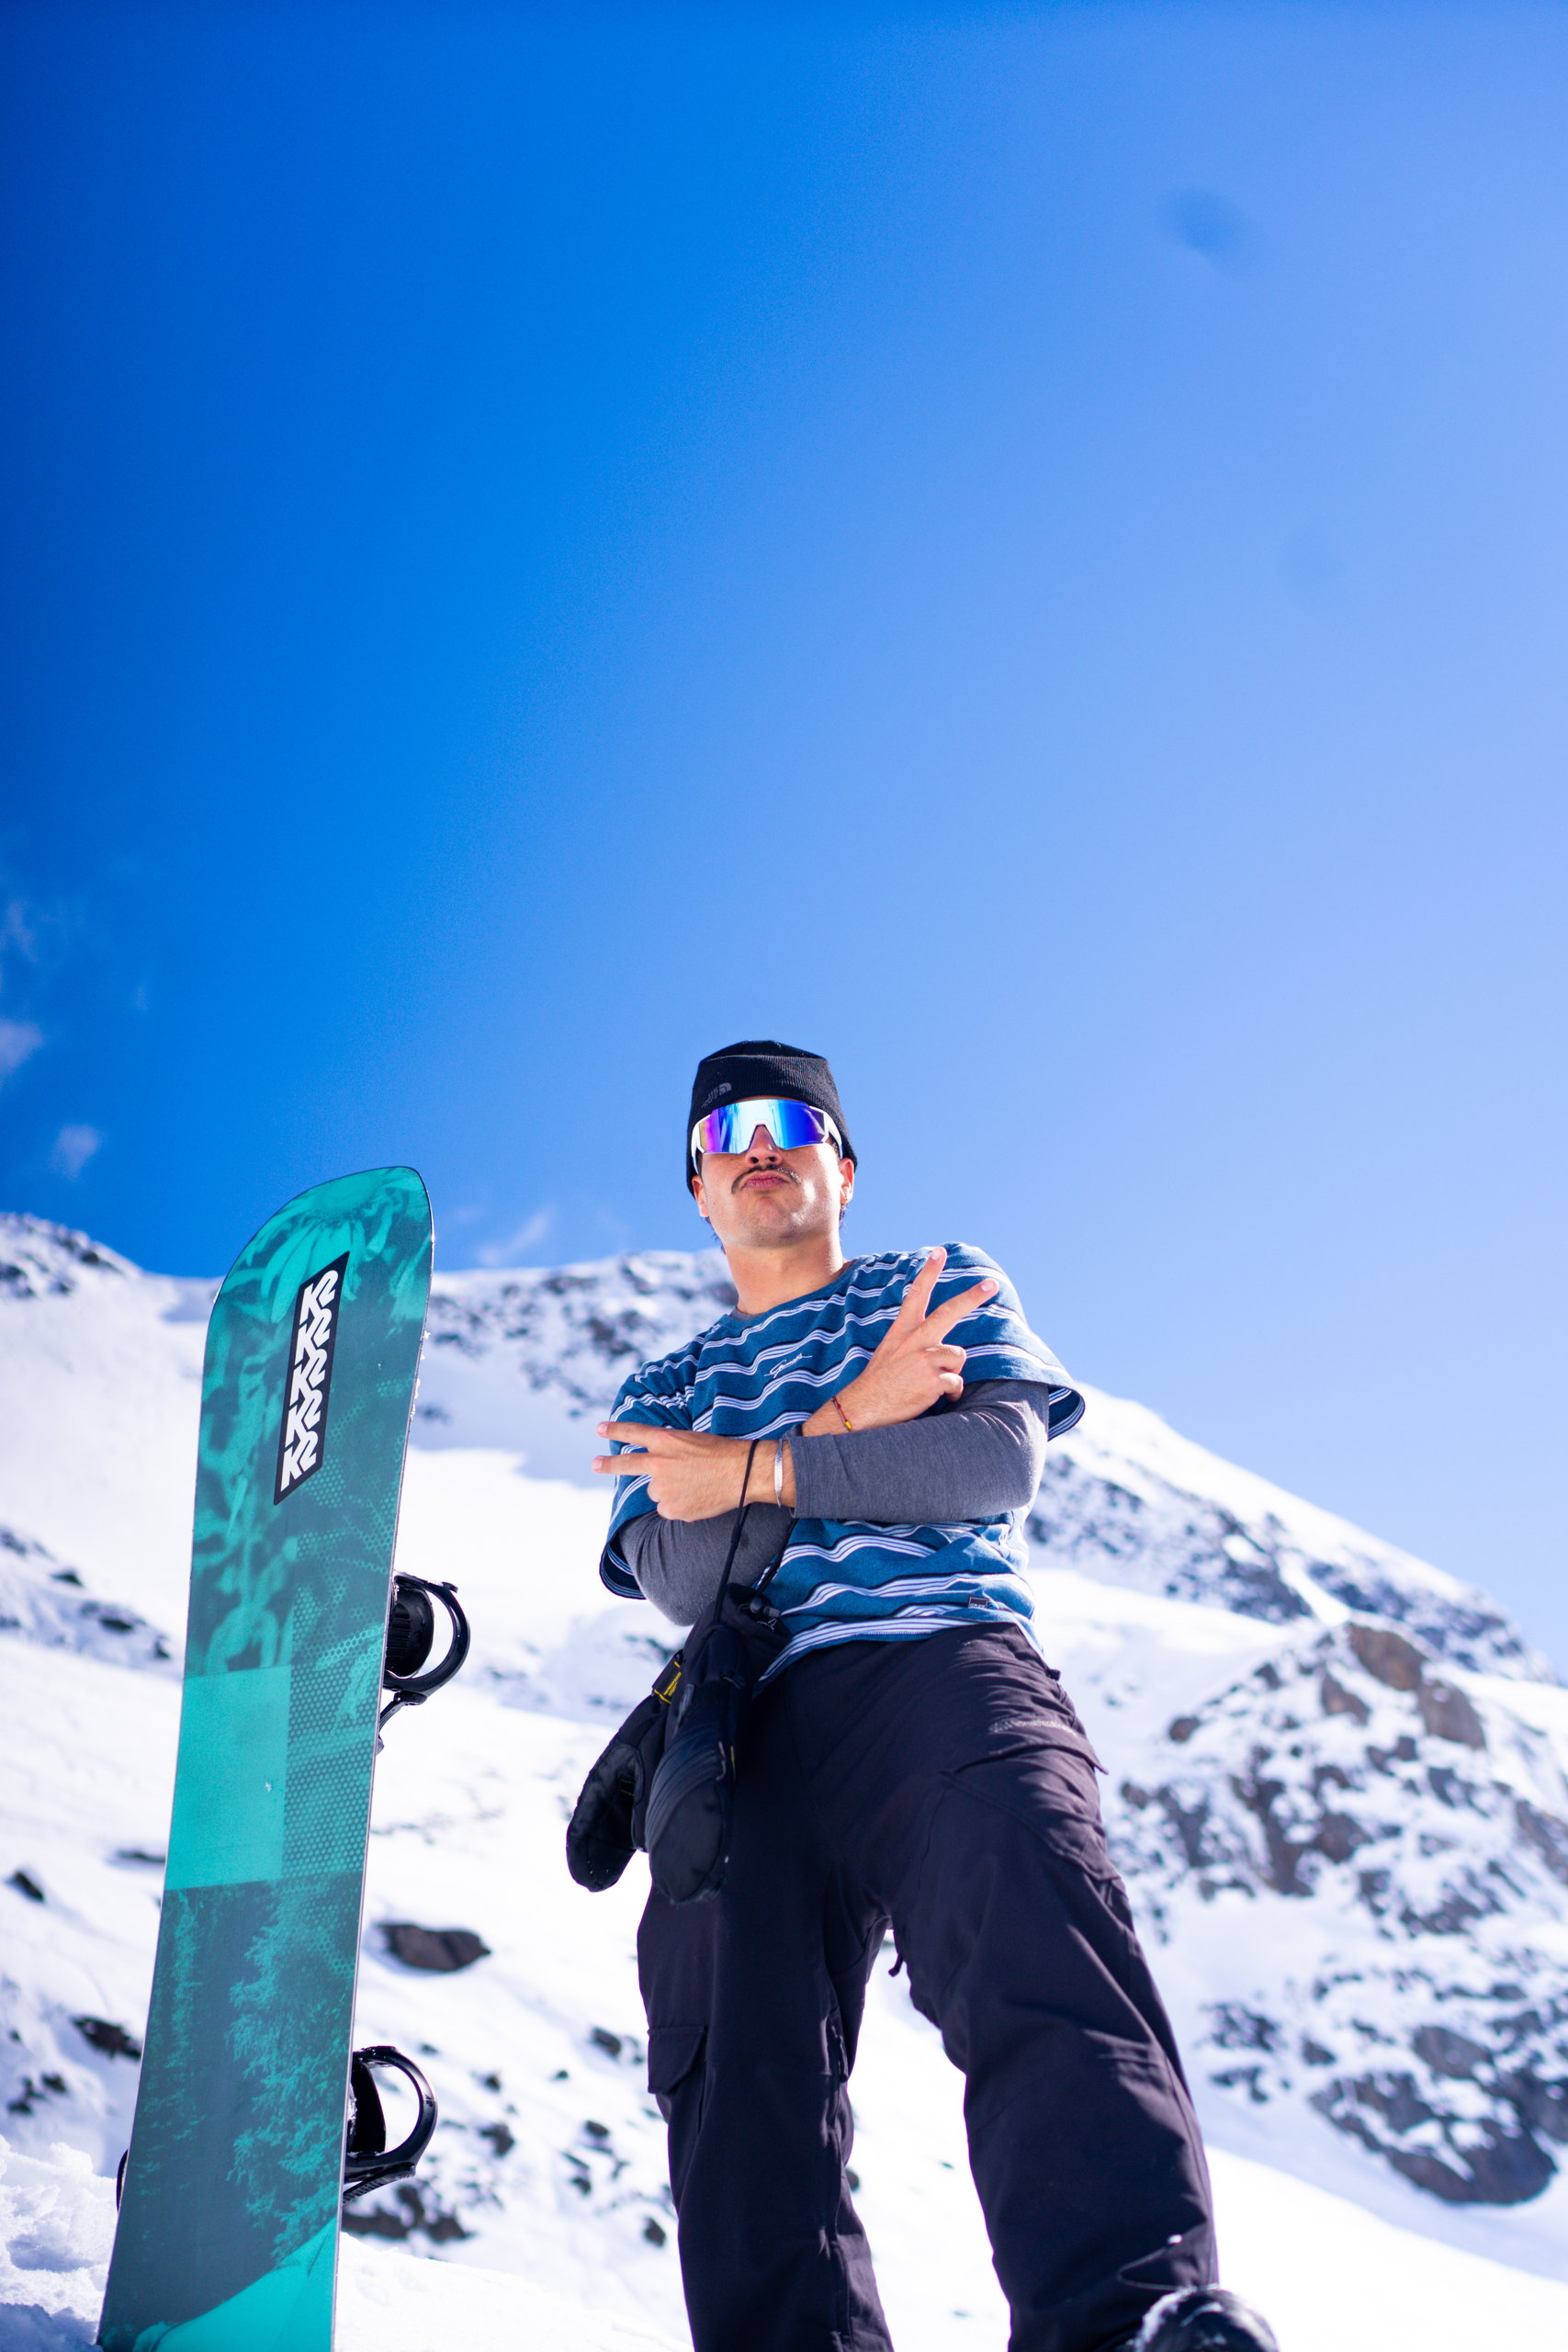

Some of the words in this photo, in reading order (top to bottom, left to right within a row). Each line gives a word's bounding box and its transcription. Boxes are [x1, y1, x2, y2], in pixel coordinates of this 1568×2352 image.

[299, 1270, 339, 1325] K2
[293, 1307, 333, 1366] K2
[289, 1348, 328, 1407] K2
[285, 1388, 323, 1448] K2
[280, 1430, 319, 1492] K2
